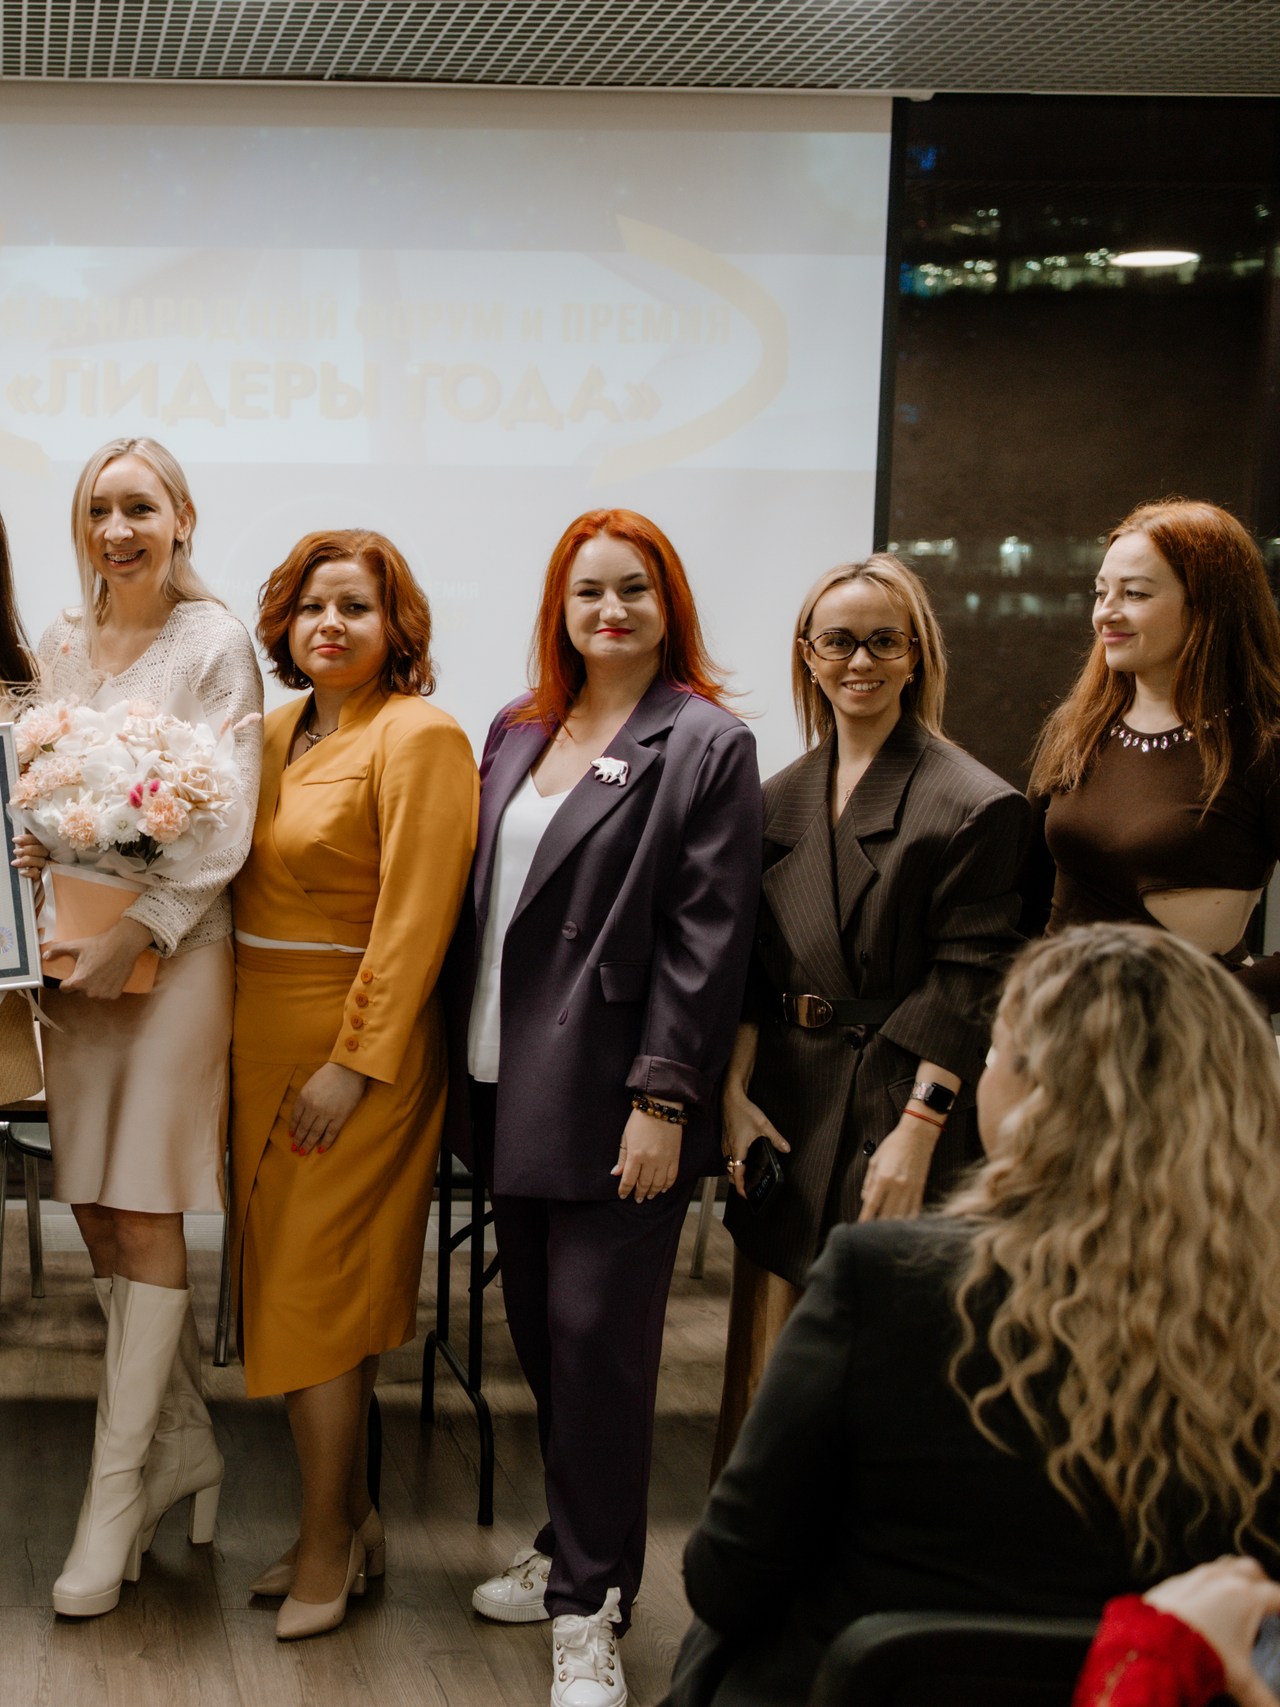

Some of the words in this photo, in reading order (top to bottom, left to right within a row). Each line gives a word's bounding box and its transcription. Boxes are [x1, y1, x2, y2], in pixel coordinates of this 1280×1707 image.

[560, 302, 733, 345] ПРЕМИЯ
[5, 358, 381, 427] «ЛИДЕРЫ
[407, 361, 664, 431] ГОДА»
